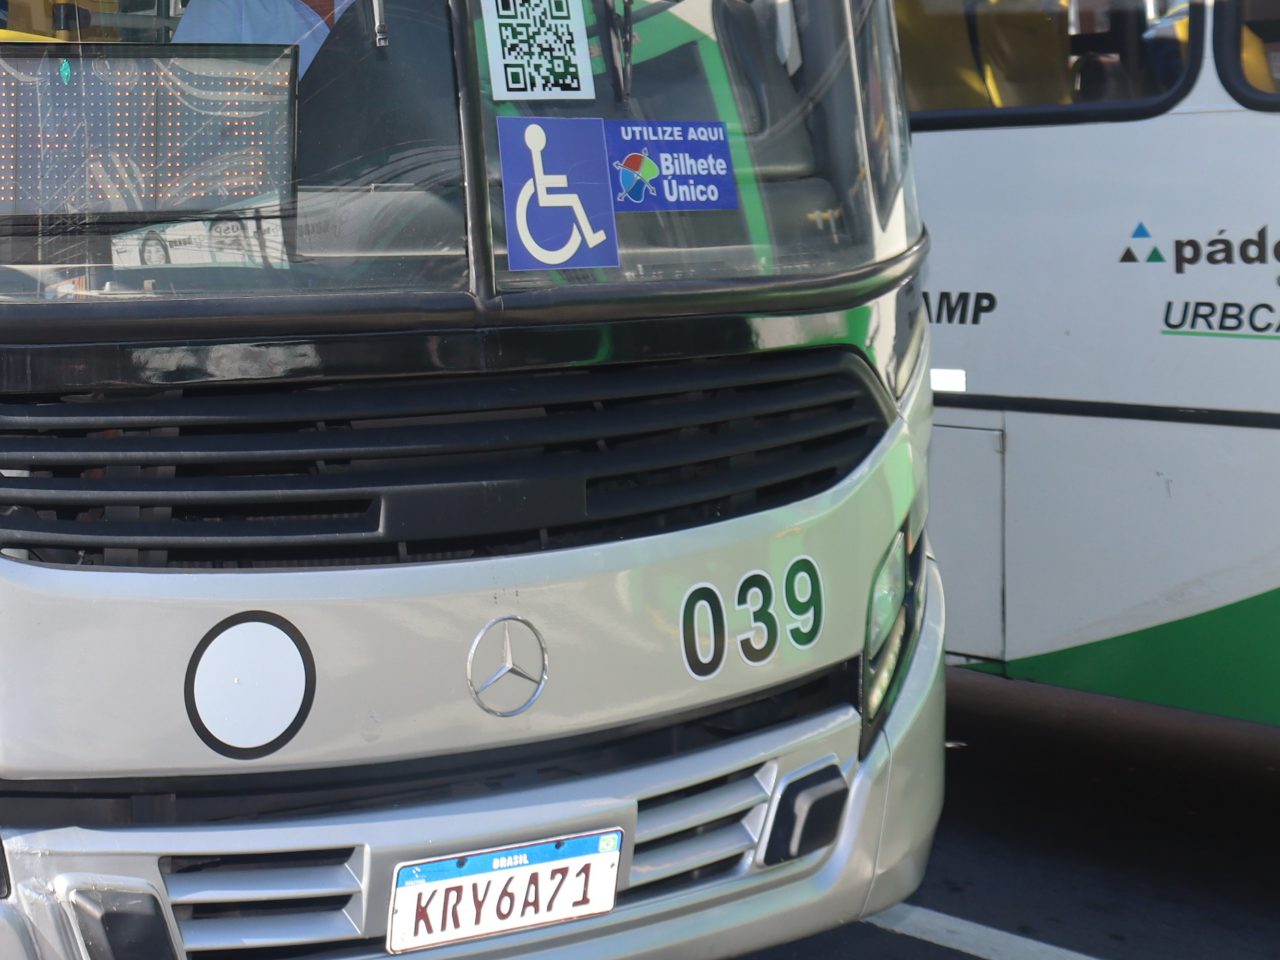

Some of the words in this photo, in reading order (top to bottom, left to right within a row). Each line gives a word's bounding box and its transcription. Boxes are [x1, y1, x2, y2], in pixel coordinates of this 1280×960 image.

[621, 126, 683, 141] UTILIZE
[687, 127, 724, 141] AQUI
[659, 152, 727, 176] Bilhete
[663, 175, 720, 202] Único
[1174, 224, 1280, 274] pád
[1164, 301, 1280, 332] URBC
[680, 554, 825, 681] 039
[492, 853, 529, 869] BRASIL
[413, 862, 592, 937] KRY6A71
